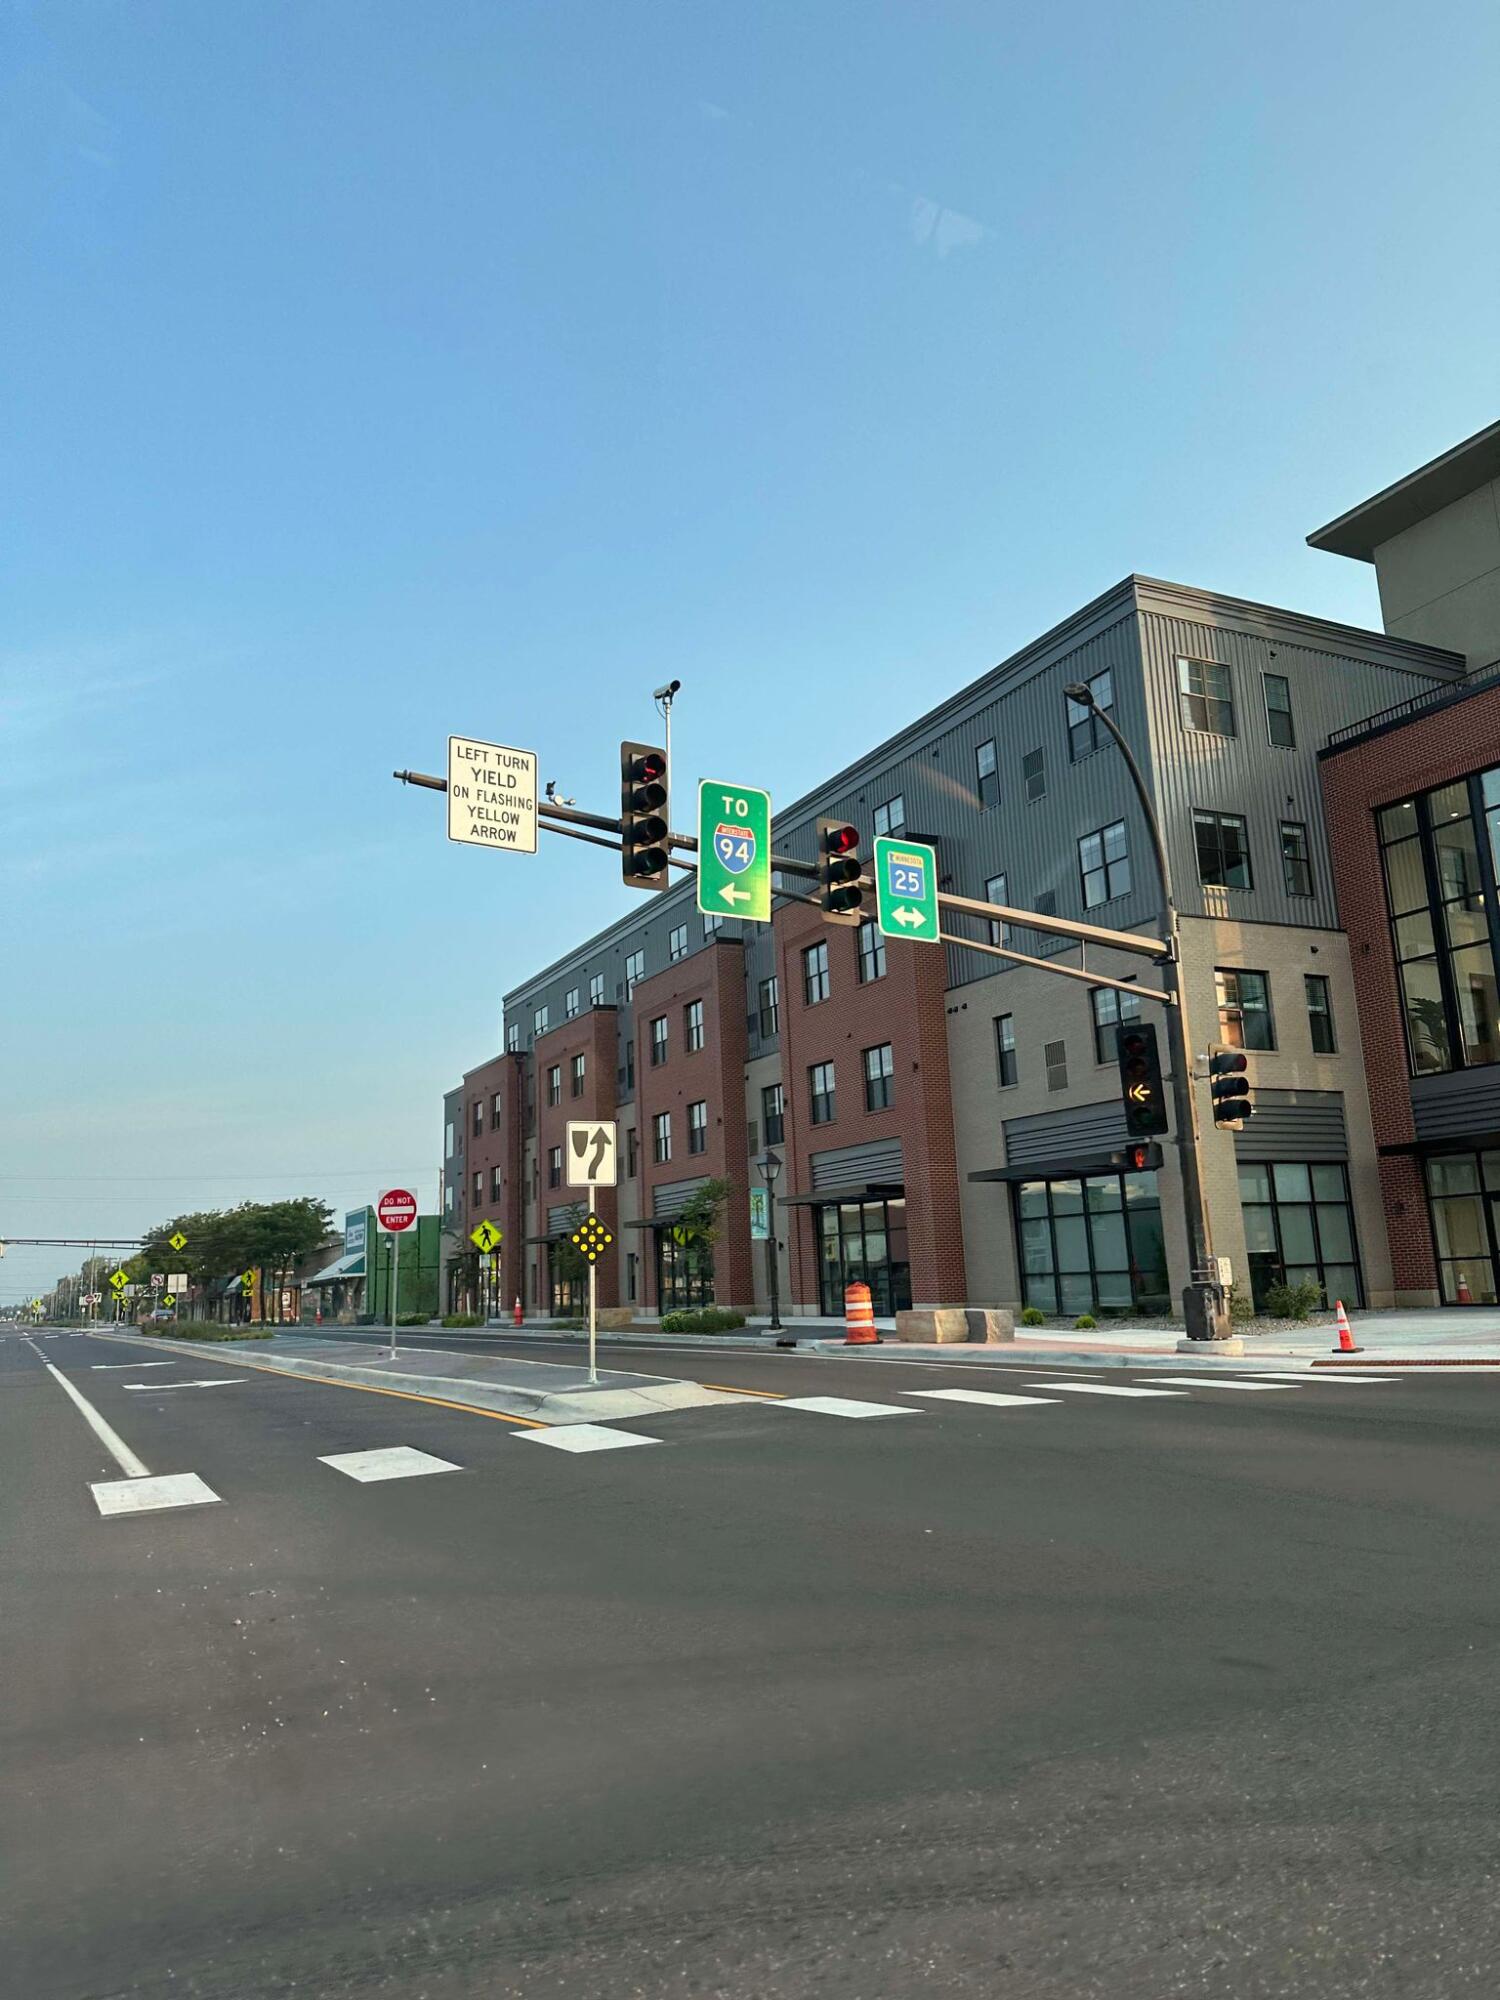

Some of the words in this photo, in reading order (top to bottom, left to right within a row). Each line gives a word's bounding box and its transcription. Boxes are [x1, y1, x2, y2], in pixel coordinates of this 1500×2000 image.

[457, 746, 489, 763] LEFT
[495, 753, 529, 771] TURN
[471, 767, 517, 788] YIELD
[453, 785, 469, 799] ON
[477, 789, 533, 811] FLASHING
[721, 796, 749, 817] TO
[467, 805, 520, 825] YELLOW
[470, 824, 517, 842] ARROW
[720, 838, 750, 864] 94
[895, 855, 922, 865] MINNESOTA
[895, 869, 920, 892] 25
[384, 1197, 394, 1205] DO
[397, 1196, 411, 1204] NOT
[385, 1215, 408, 1224] ENTER
